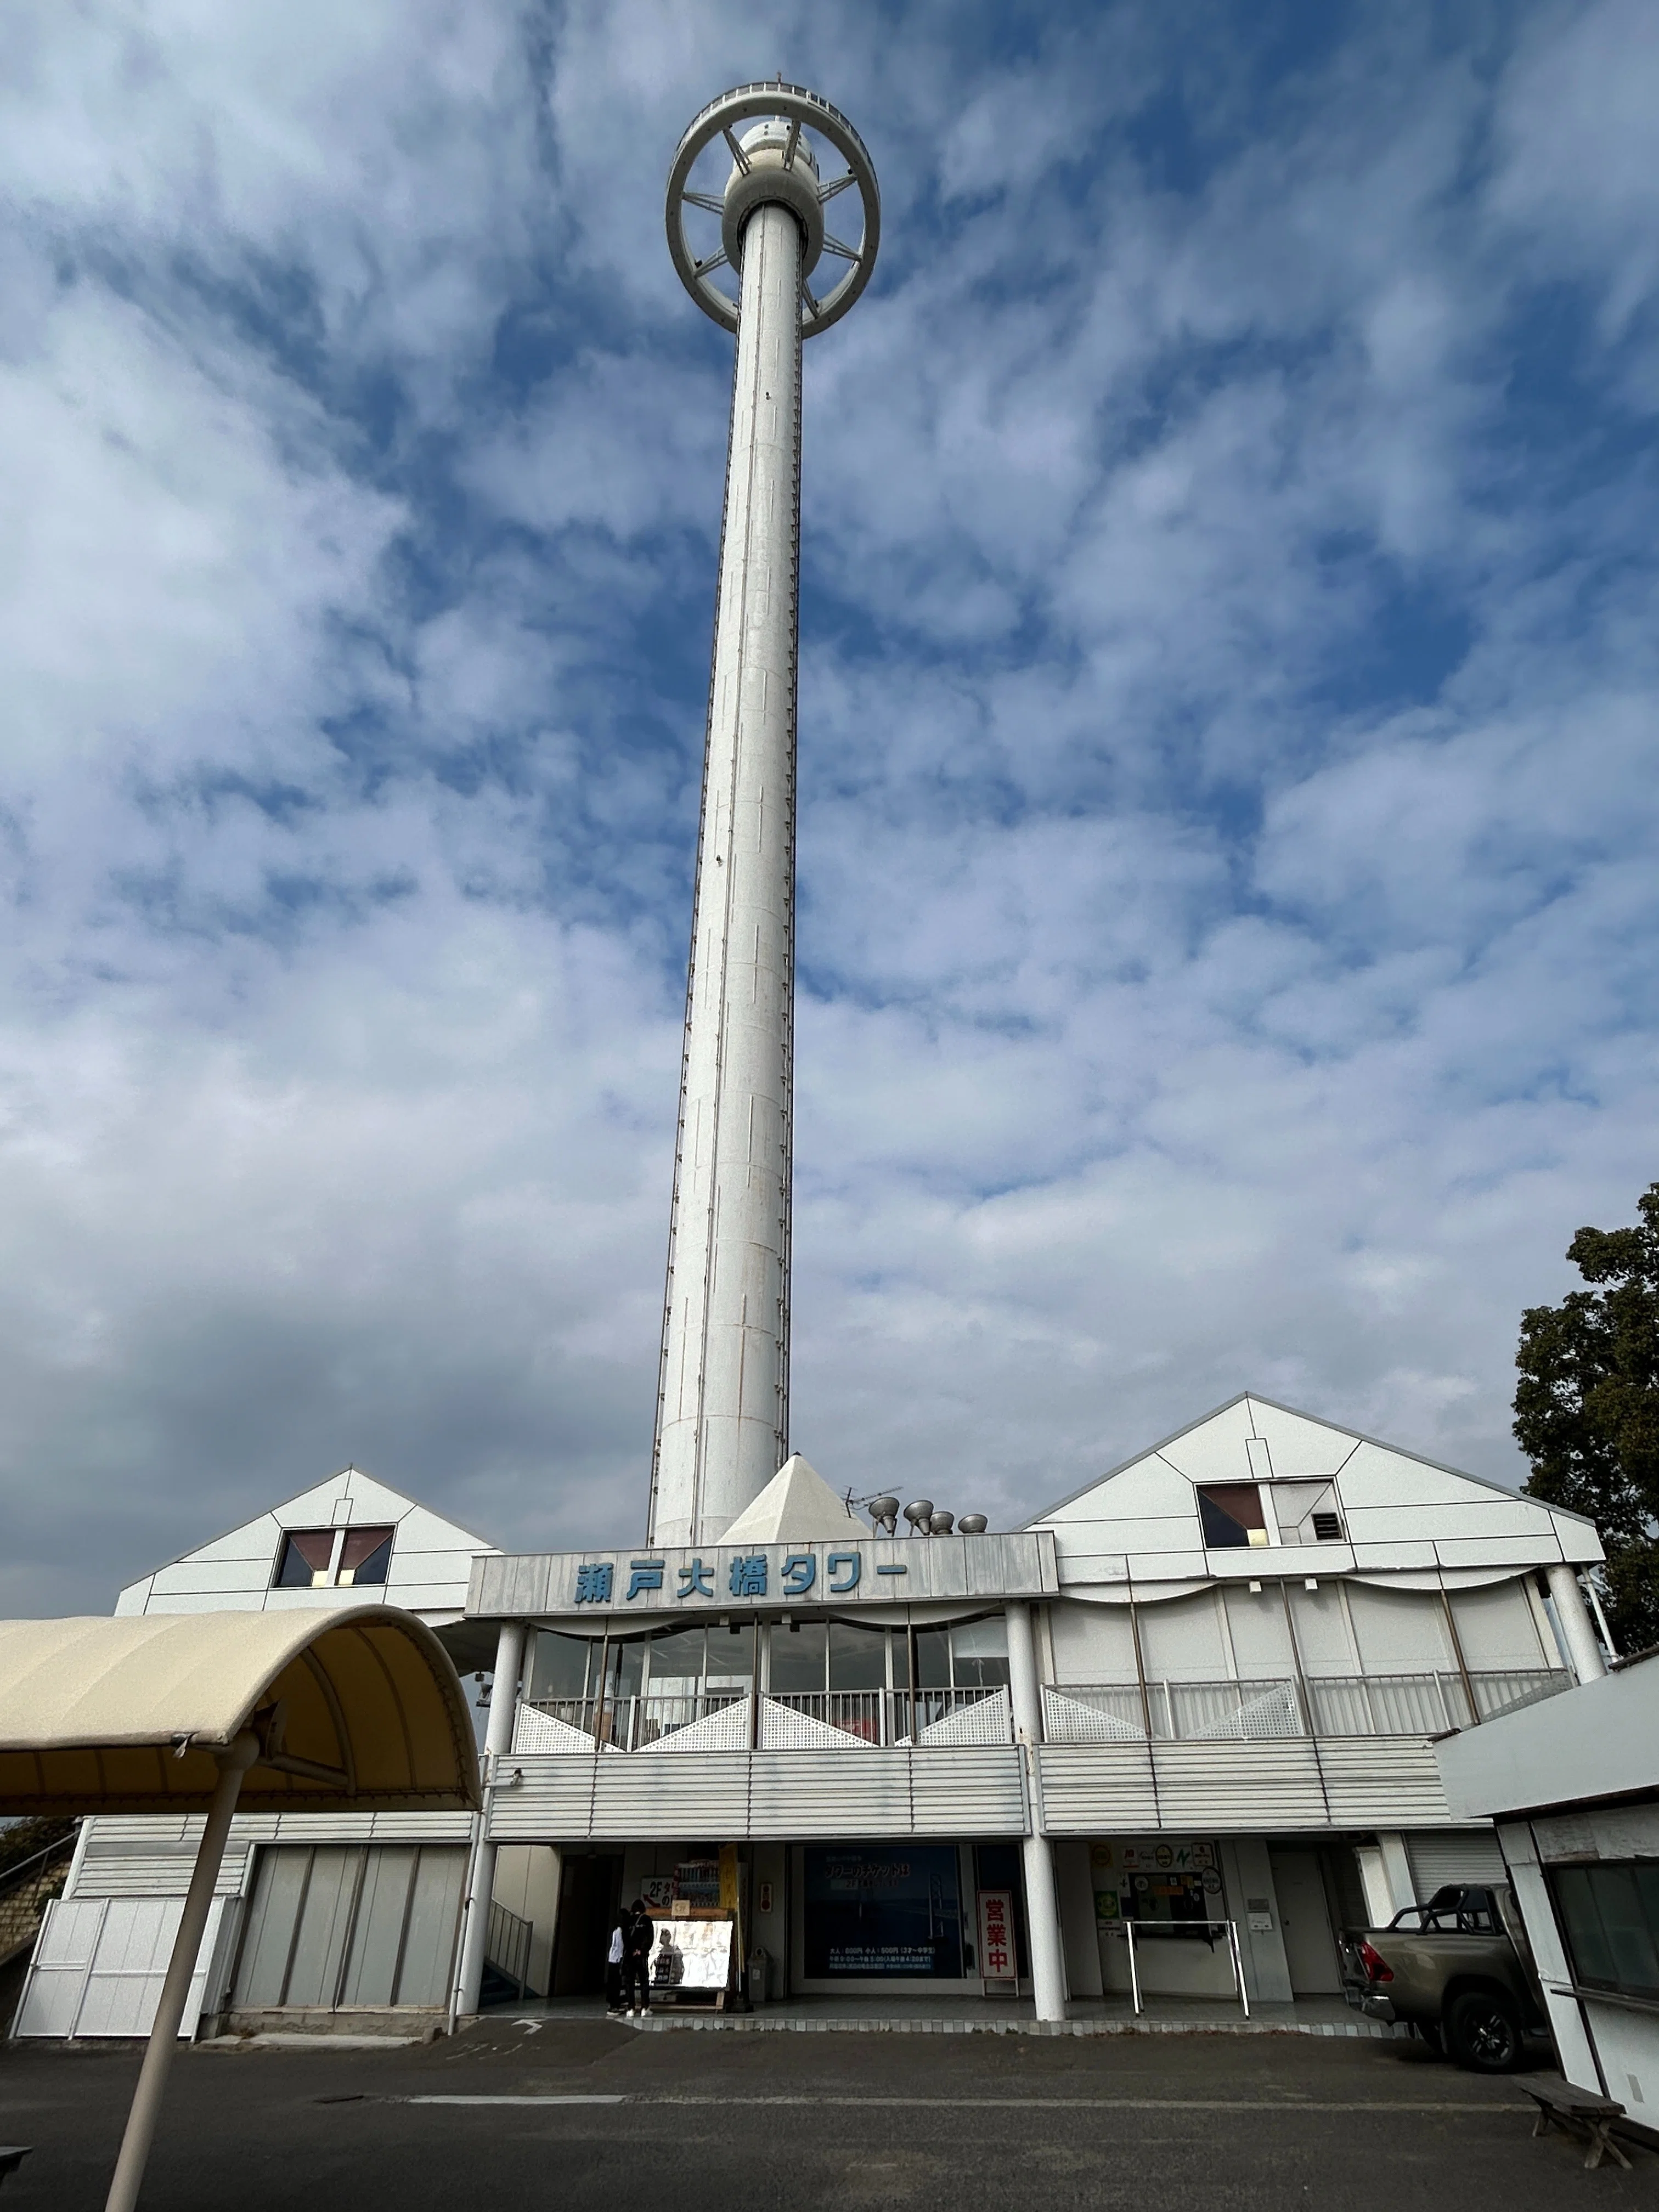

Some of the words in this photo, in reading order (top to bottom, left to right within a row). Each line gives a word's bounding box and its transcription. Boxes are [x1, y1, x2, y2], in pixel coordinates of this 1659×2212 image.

[574, 1552, 906, 1602] 瀬戸大橋タワー
[650, 1881, 662, 1898] 2F
[985, 1899, 1008, 1973] 営業中
